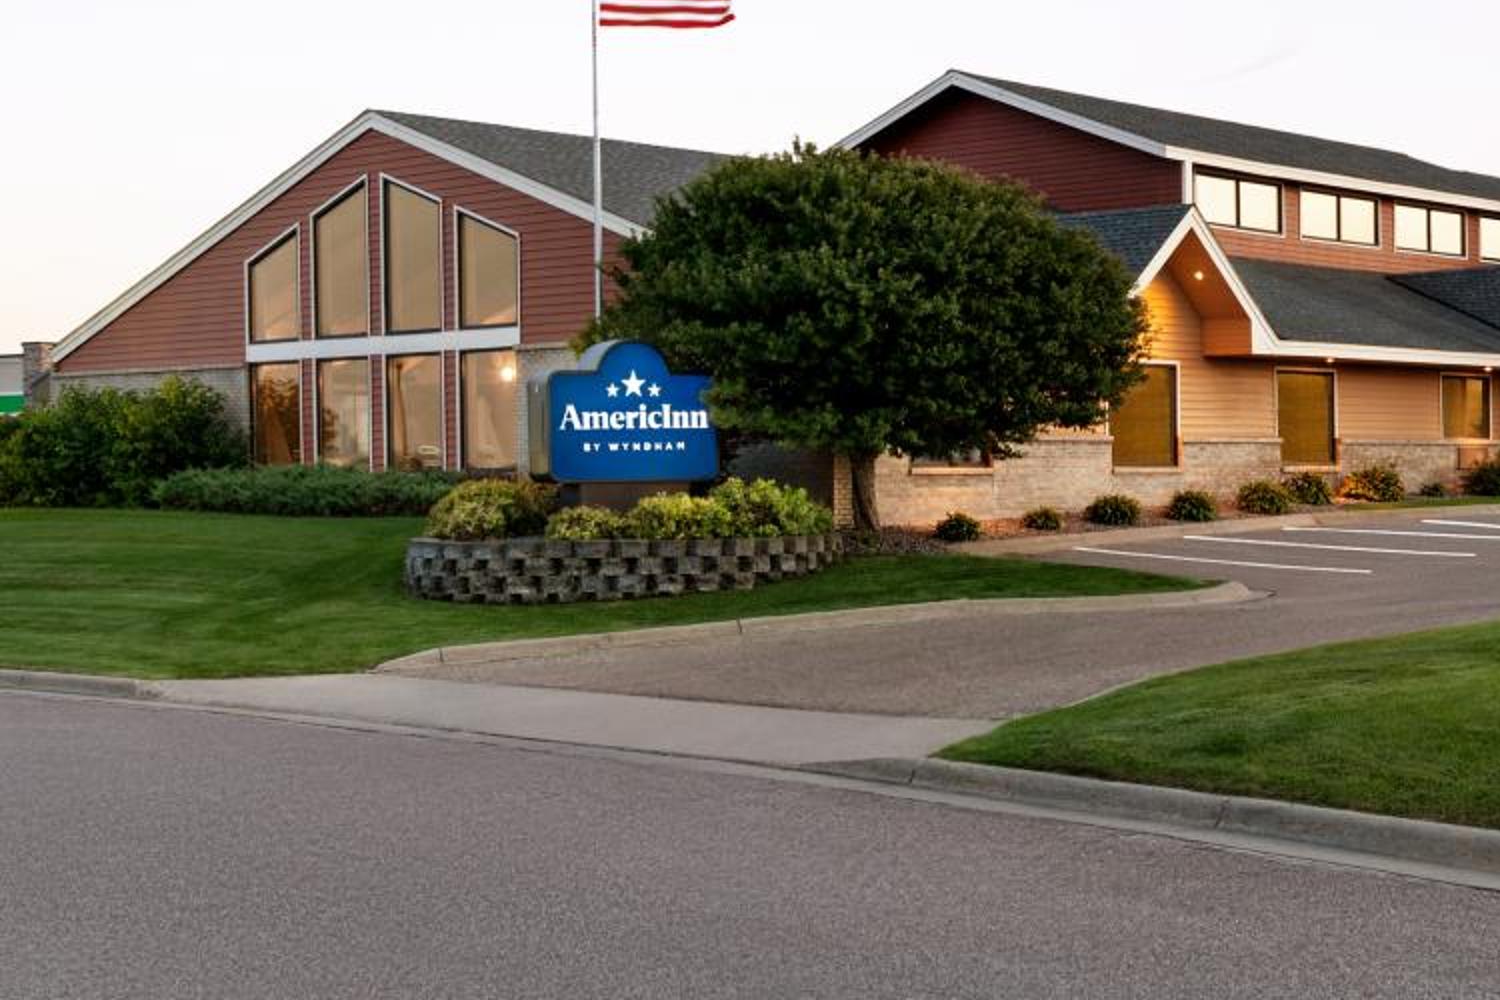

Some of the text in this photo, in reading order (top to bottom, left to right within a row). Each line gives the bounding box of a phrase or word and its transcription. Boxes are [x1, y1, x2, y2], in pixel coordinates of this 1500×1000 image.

[560, 403, 709, 431] AmericInn
[583, 441, 685, 452] BY WYNDHAM
